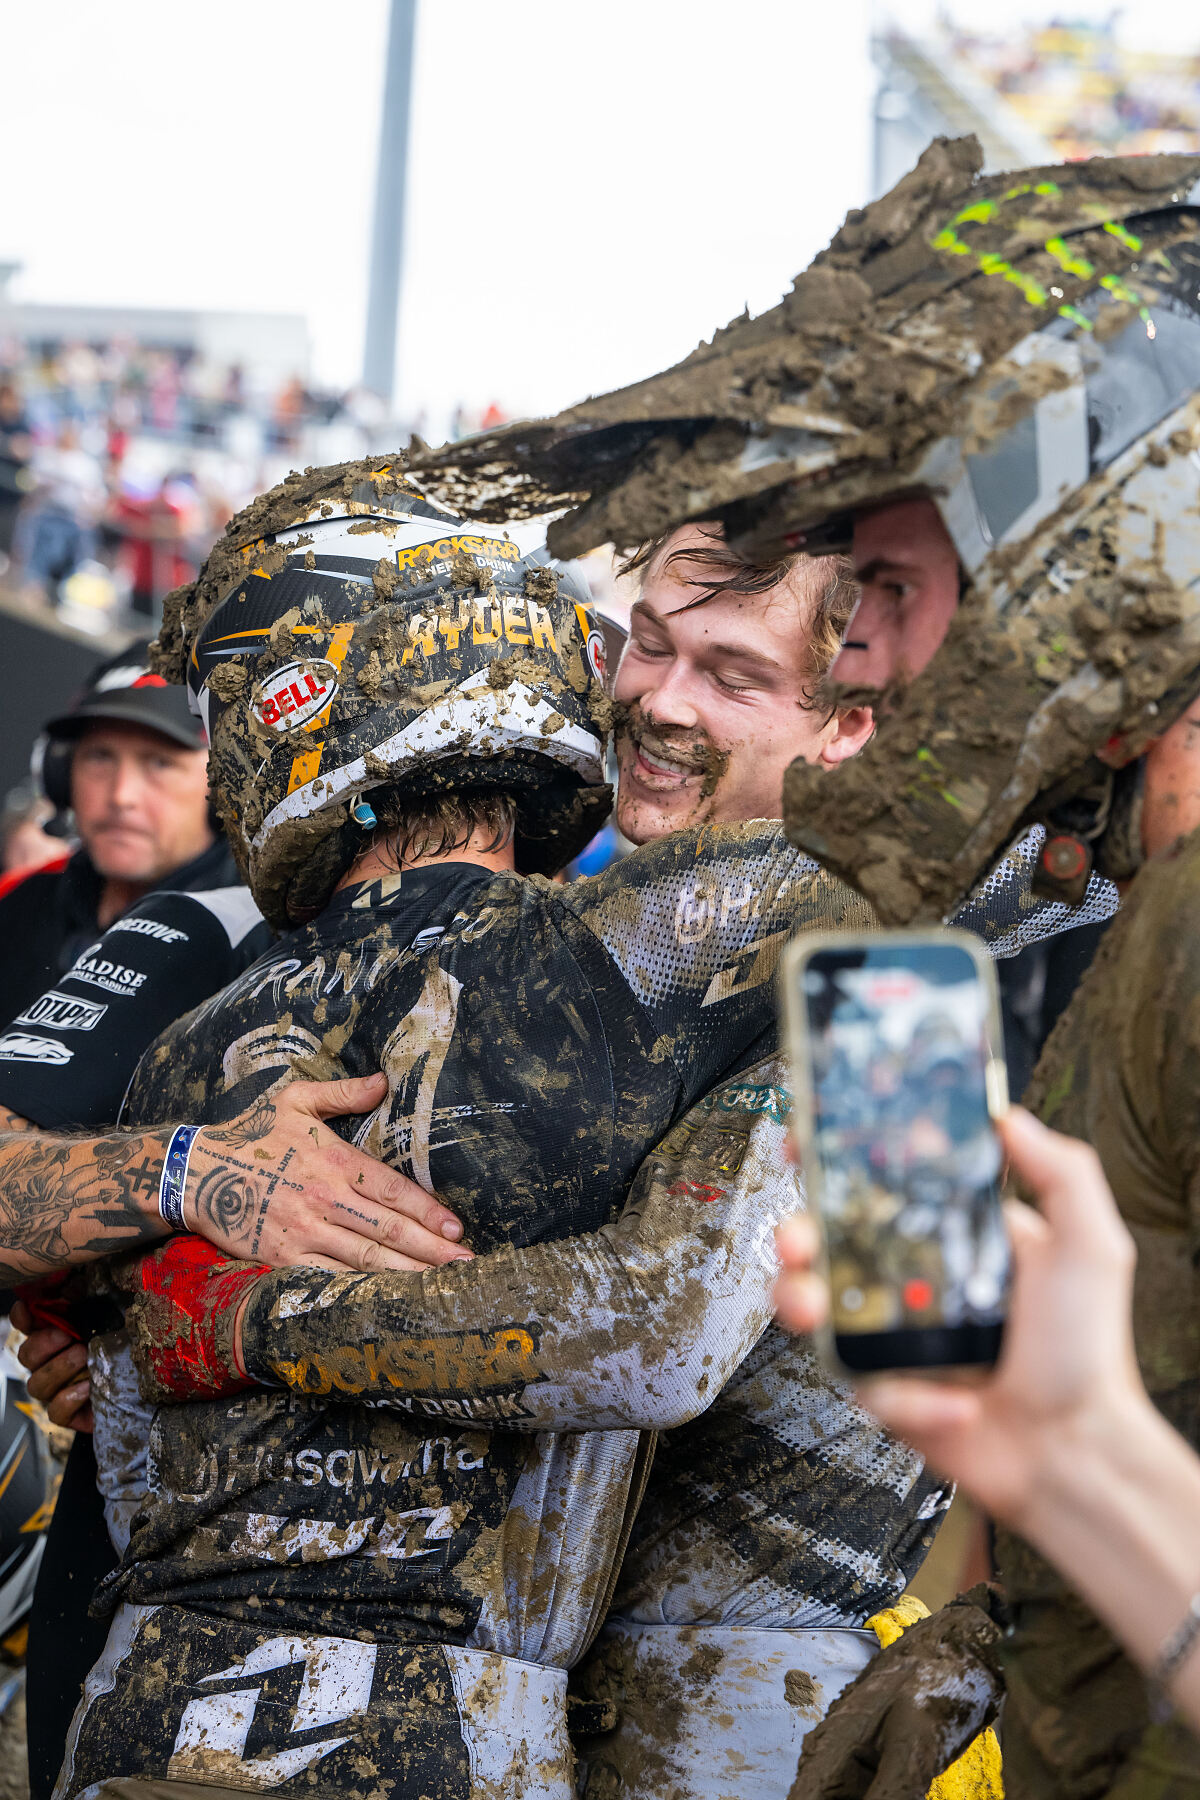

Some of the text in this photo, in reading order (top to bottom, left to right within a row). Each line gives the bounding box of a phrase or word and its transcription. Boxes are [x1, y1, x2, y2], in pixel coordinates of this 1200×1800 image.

[398, 535, 520, 571] ROCKSTAR
[476, 556, 516, 573] DRINK
[261, 673, 327, 726] BELL
[196, 1145, 255, 1172] REMEMBER
[260, 1197, 271, 1215] THE
[277, 1146, 297, 1173] LIMIT
[282, 1178, 380, 1227] YOU STARTED
